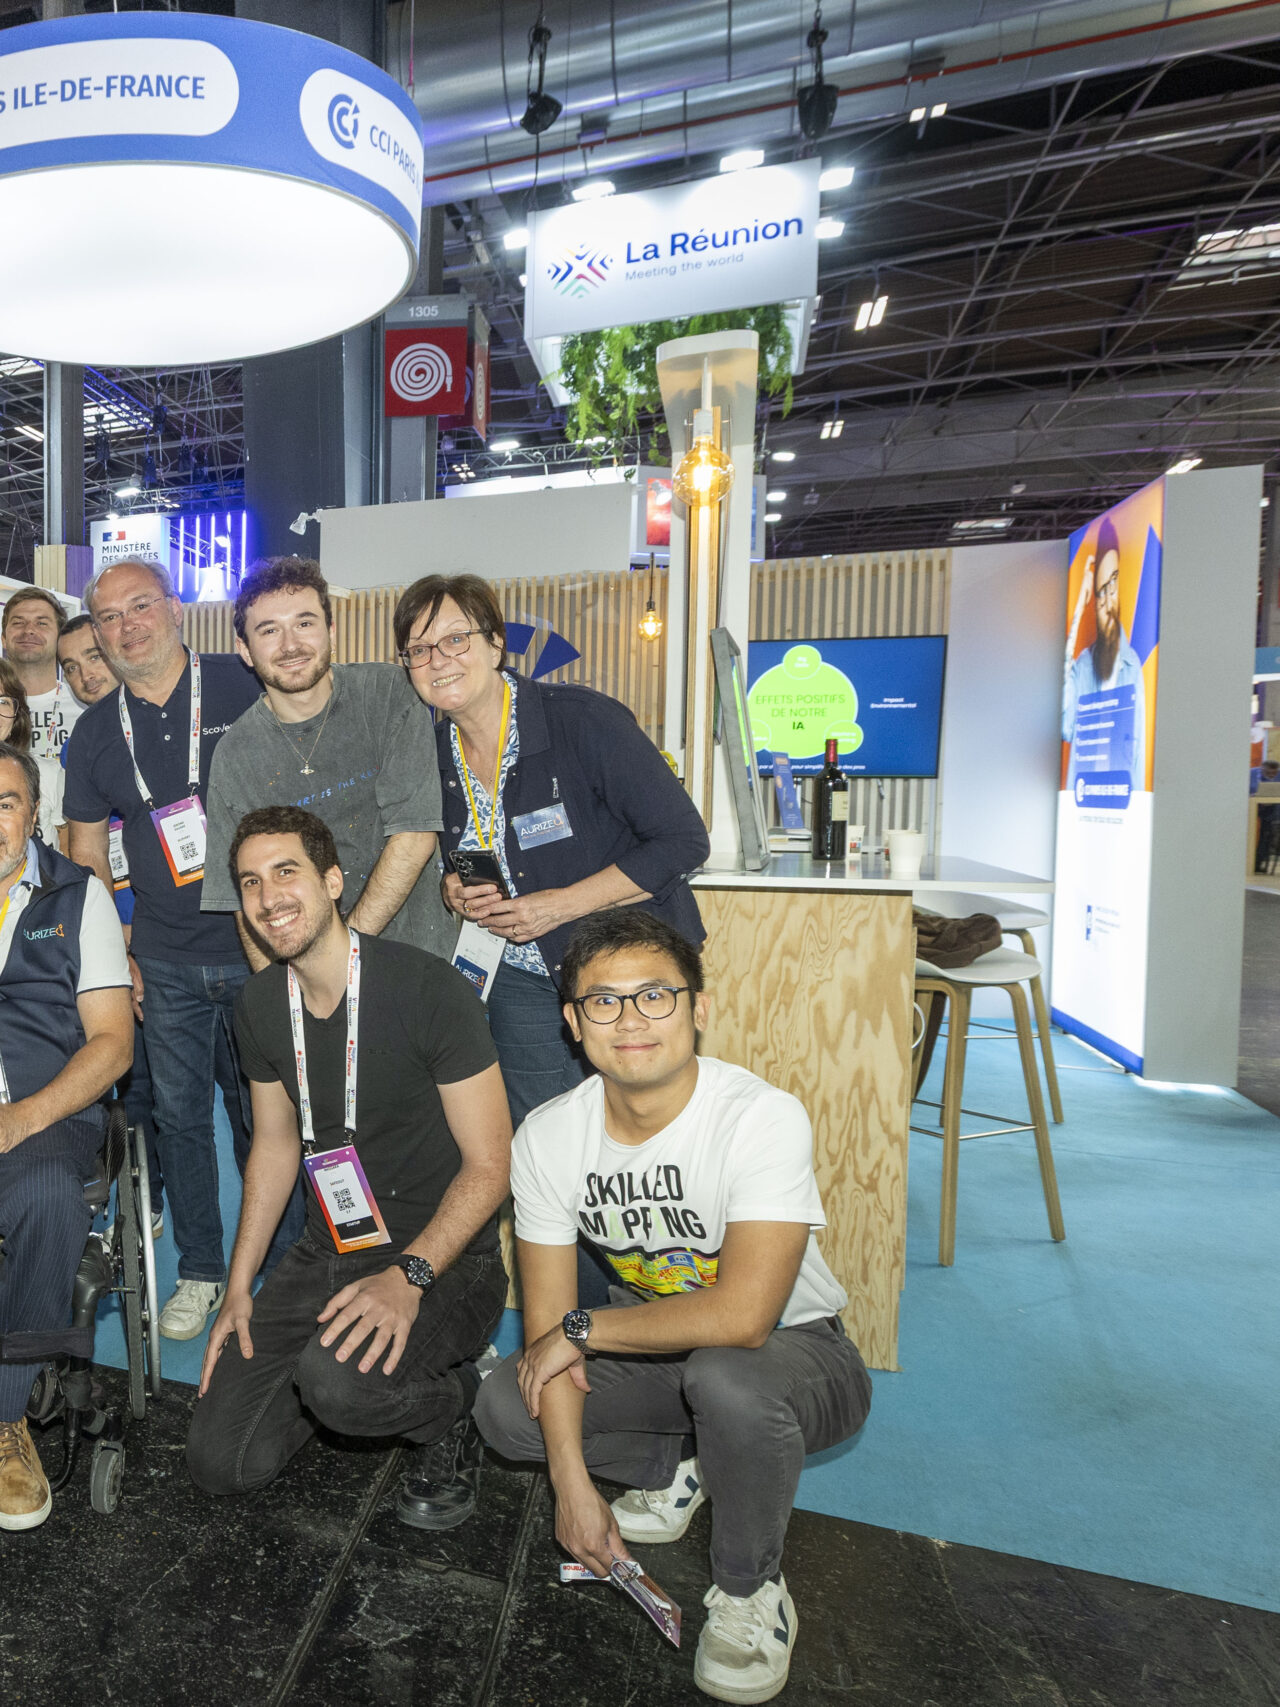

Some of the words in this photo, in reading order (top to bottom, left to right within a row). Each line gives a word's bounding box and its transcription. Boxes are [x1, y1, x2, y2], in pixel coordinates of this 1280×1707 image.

[13, 74, 206, 111] ILE-DE-FRANCE
[370, 125, 390, 156] CCI
[393, 141, 416, 185] PARIS
[626, 242, 660, 264] La
[670, 217, 804, 257] Réunion
[625, 264, 677, 281] Meeting
[681, 260, 703, 273] the
[707, 253, 744, 268] world
[408, 305, 439, 318] 1305
[102, 542, 152, 554] MINISTÈRE
[755, 695, 793, 705] EFFETS
[796, 694, 846, 704] POSITIFS
[771, 708, 787, 718] DE
[789, 707, 828, 717] NOTRE
[202, 723, 233, 736] Scove
[792, 721, 805, 730] IA
[578, 1206, 707, 1241] MAPPING
